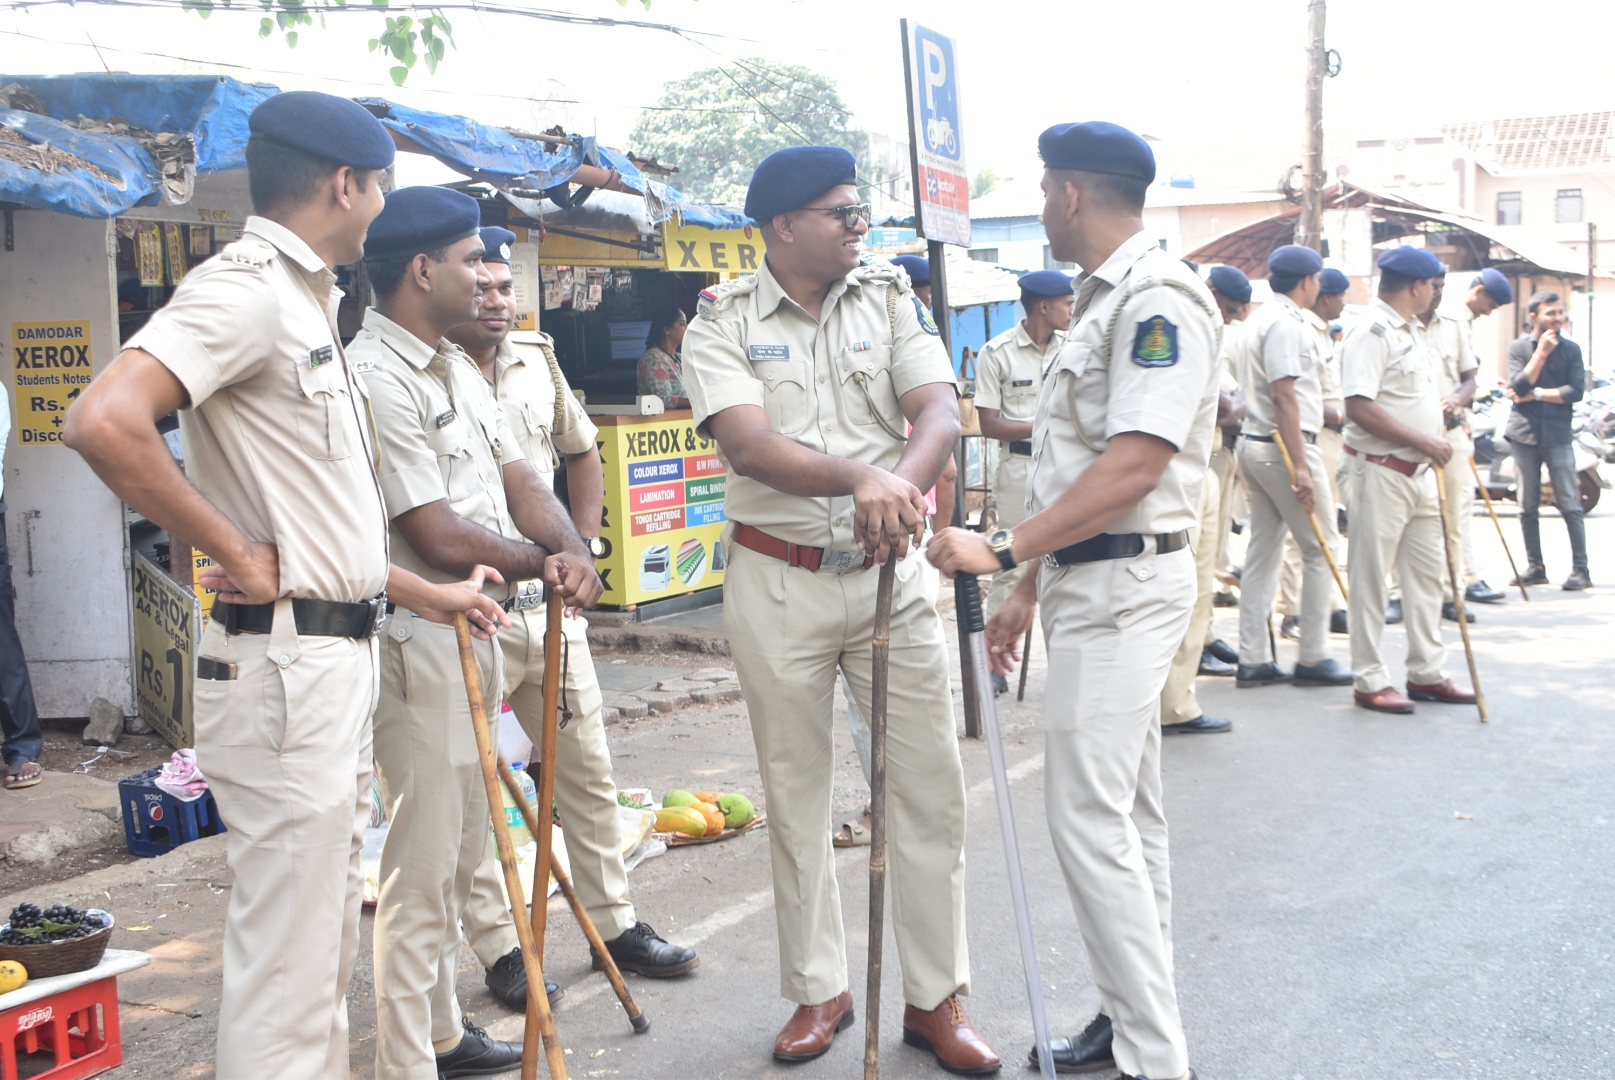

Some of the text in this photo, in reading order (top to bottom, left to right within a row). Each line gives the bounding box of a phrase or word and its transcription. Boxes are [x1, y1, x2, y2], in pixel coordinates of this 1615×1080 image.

[922, 38, 946, 110] P
[18, 326, 83, 340] DAMODAR
[15, 345, 90, 369] XEROX
[17, 373, 91, 386] Students Notes
[31, 396, 65, 411] Rs.
[626, 428, 681, 458] XEROX
[685, 427, 696, 451] &
[633, 463, 678, 479] COLOUR XEROX
[640, 489, 675, 504] LAMINATION
[690, 486, 709, 497] SPIRAL
[635, 509, 681, 525] TONOR CARTRIDGE
[694, 505, 703, 515] INK
[703, 513, 720, 523] FILLING
[646, 520, 671, 533] REFILLING
[136, 567, 190, 640] XEROX
[136, 597, 189, 655] A4 & Legal
[141, 648, 183, 726] Rs. 1
[181, 730, 188, 744] 2
[144, 793, 163, 802] pepsi
